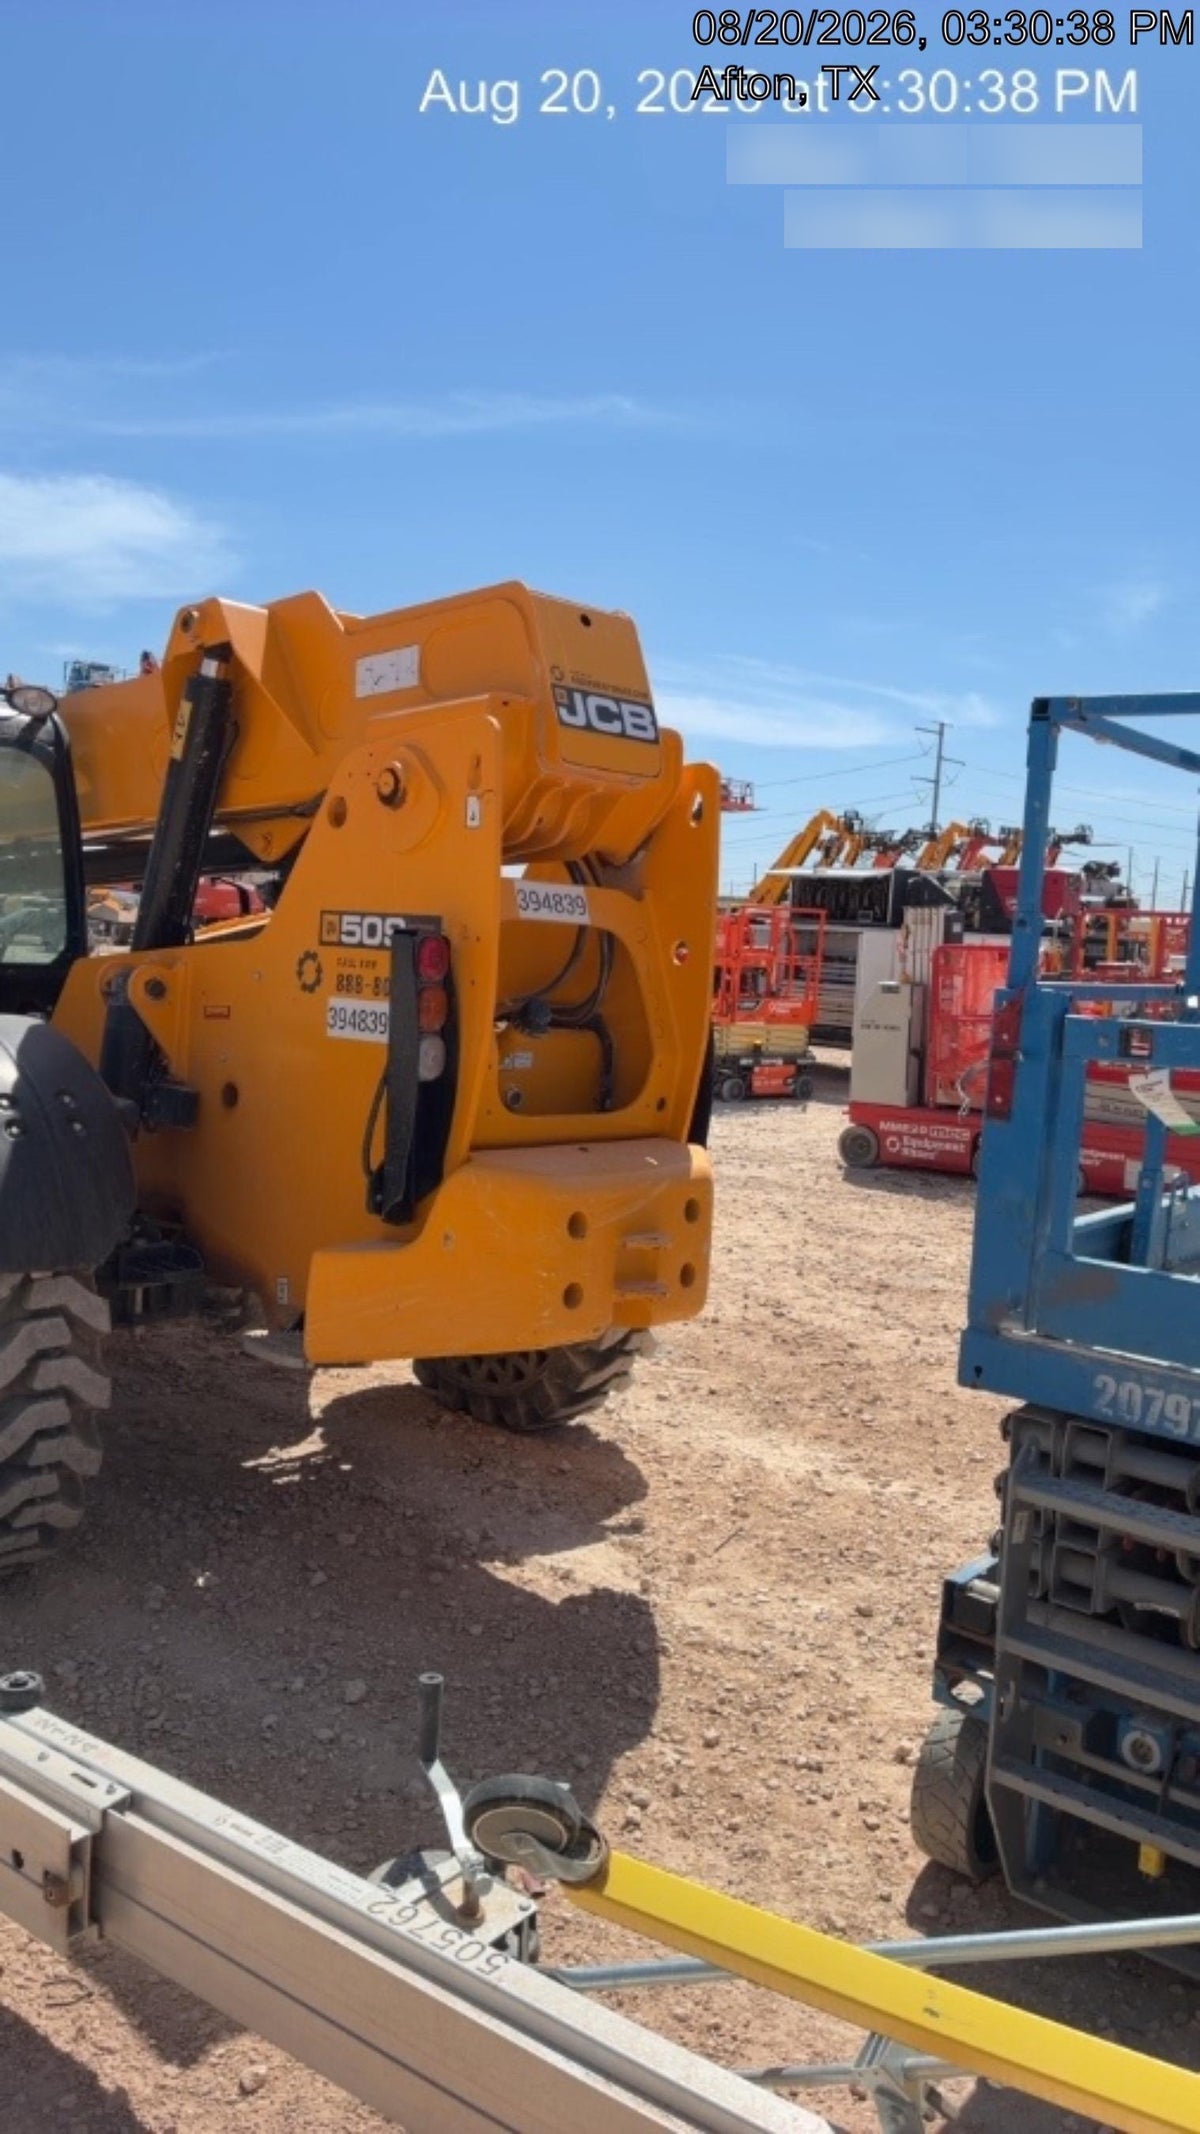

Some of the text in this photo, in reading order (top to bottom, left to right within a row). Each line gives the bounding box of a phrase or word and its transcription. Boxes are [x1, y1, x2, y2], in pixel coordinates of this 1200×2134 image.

[558, 691, 656, 741] JCB
[516, 888, 587, 916] 394839
[327, 1006, 389, 1035] 394839
[366, 1893, 509, 1976] 505762
